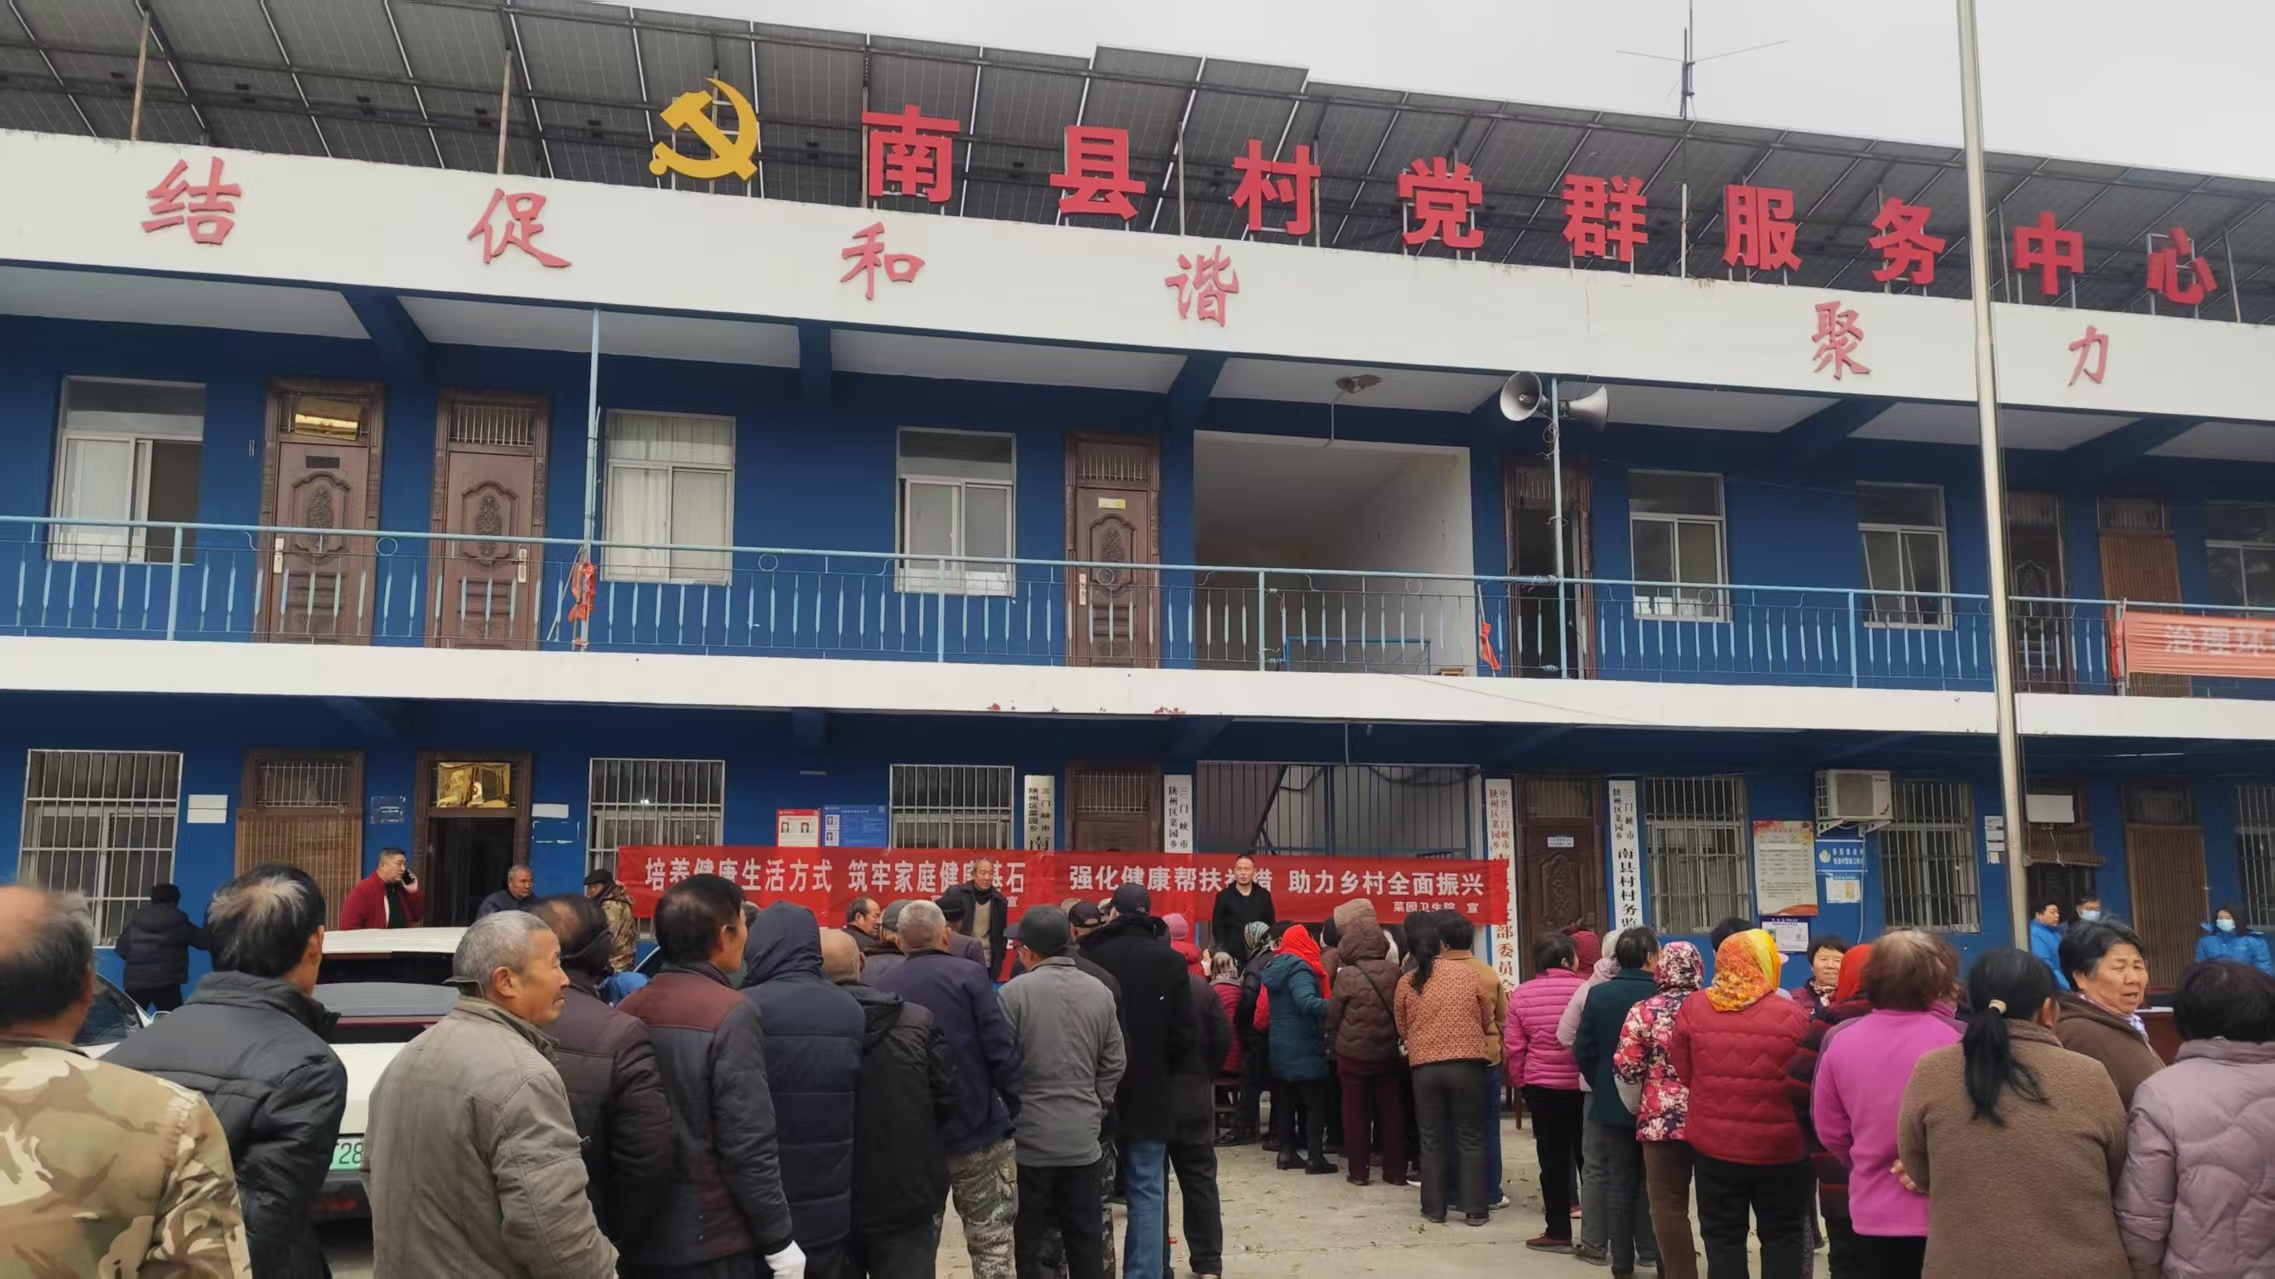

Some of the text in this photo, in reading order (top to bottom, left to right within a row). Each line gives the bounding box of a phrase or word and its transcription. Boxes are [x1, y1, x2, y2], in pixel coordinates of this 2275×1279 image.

[861, 104, 2218, 305] 南县村党群服务中心
[1168, 786, 1179, 849] 陕州区菜园乡
[1179, 787, 1189, 849] 三门峡市
[645, 857, 833, 892] 培养健康生活方式
[1288, 869, 1484, 897] 助力乡村全面振兴
[1393, 901, 1479, 914] 菜园卫生院 宣
[336, 1142, 364, 1165] 28
